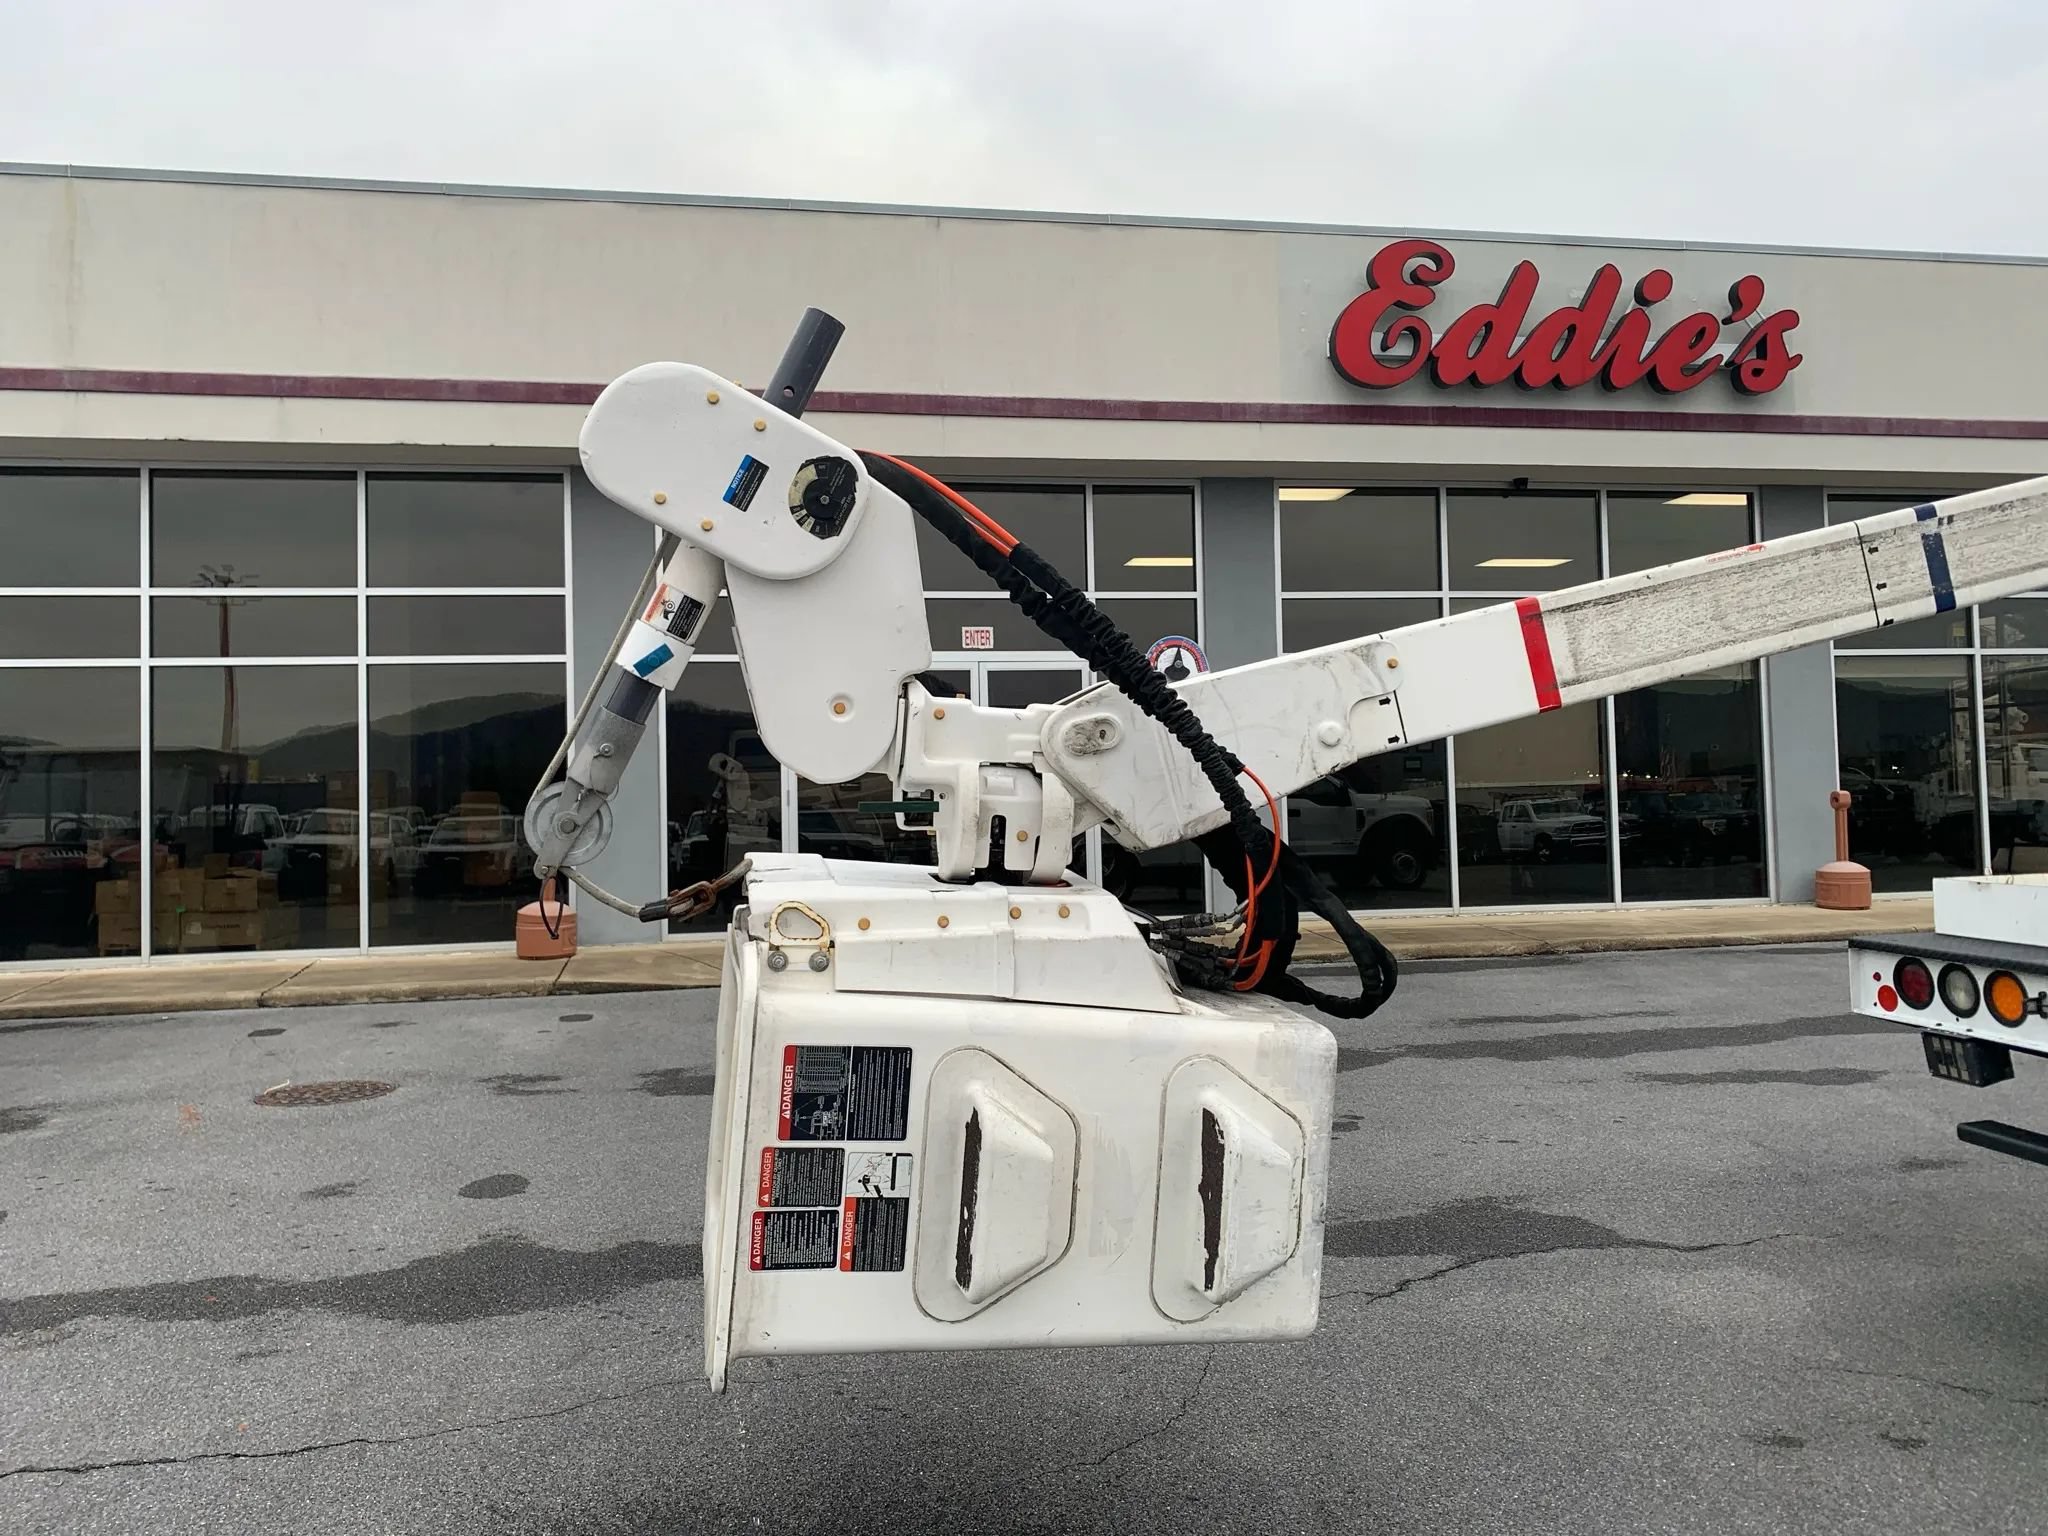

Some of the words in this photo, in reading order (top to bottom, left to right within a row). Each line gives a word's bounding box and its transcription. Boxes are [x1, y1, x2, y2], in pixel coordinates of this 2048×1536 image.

[1330, 239, 1803, 395] Eddie's
[731, 469, 744, 489] NOTICE
[964, 629, 992, 647] ENTER
[782, 1065, 794, 1109] DANGER
[762, 1152, 772, 1188] DANGER
[753, 1218, 762, 1255] DANGER
[844, 1211, 854, 1247] DANGER
